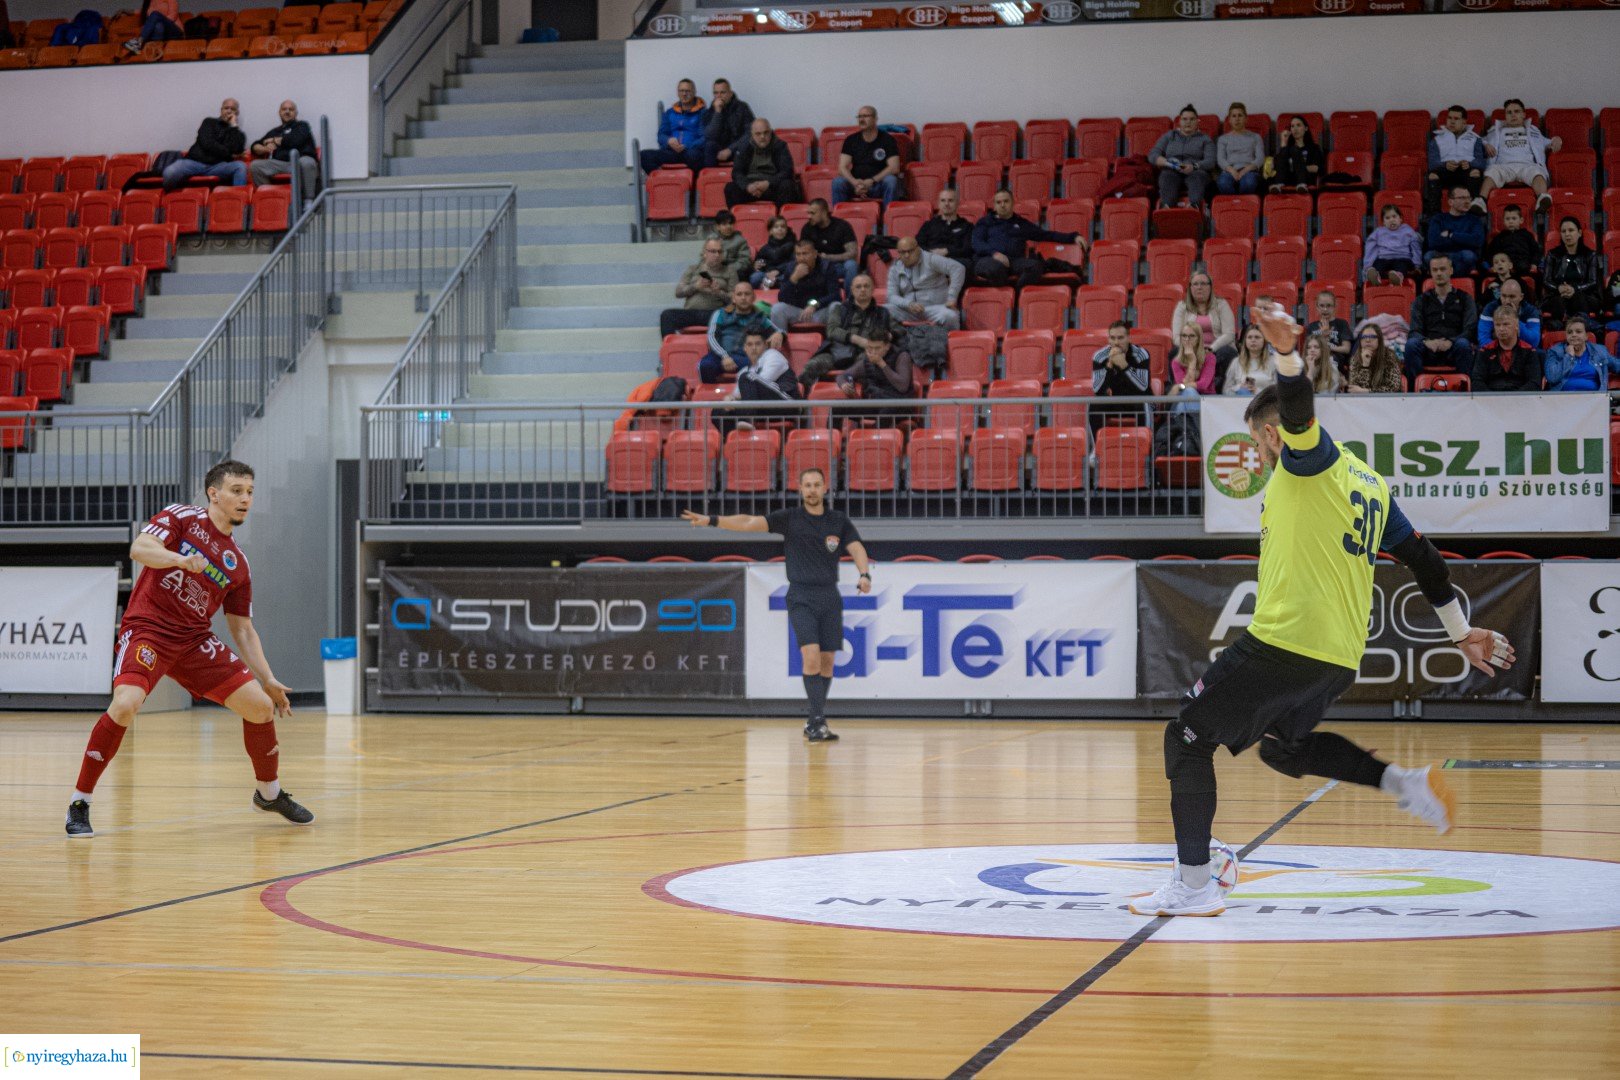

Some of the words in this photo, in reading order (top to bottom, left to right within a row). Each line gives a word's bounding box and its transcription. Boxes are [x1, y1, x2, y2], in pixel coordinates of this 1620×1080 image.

[951, 6, 971, 14] Bige
[1086, 1, 1105, 10] Bige
[1108, 0, 1140, 9] Holding
[1181, 0, 1207, 15] BH
[1228, 6, 1265, 15] Csoport
[1369, 2, 1405, 11] Csoport
[691, 14, 712, 23] Bige
[713, 14, 743, 23] Holding
[819, 10, 839, 19] Bige
[840, 9, 873, 18] Holding
[914, 9, 942, 23] BH
[960, 14, 995, 24] Csoport
[1048, 7, 1076, 20] BH
[1095, 10, 1130, 19] Csoport
[655, 16, 684, 33] BH
[701, 23, 734, 32] Csoport
[828, 19, 863, 28] Csoport
[1342, 432, 1604, 479] lsz.hu
[1390, 480, 1490, 499] abdarúgó
[1498, 479, 1604, 497] Szövetség
[159, 577, 207, 618] STUDIO
[657, 598, 737, 632] 90
[768, 584, 1023, 679] Ta-Te
[1025, 629, 1108, 677] KFT
[398, 651, 656, 670] ÉPÍTÉSZTERVEZŐ
[677, 653, 734, 670] KFT
[815, 896, 1539, 919] NYÍREHÁZA
